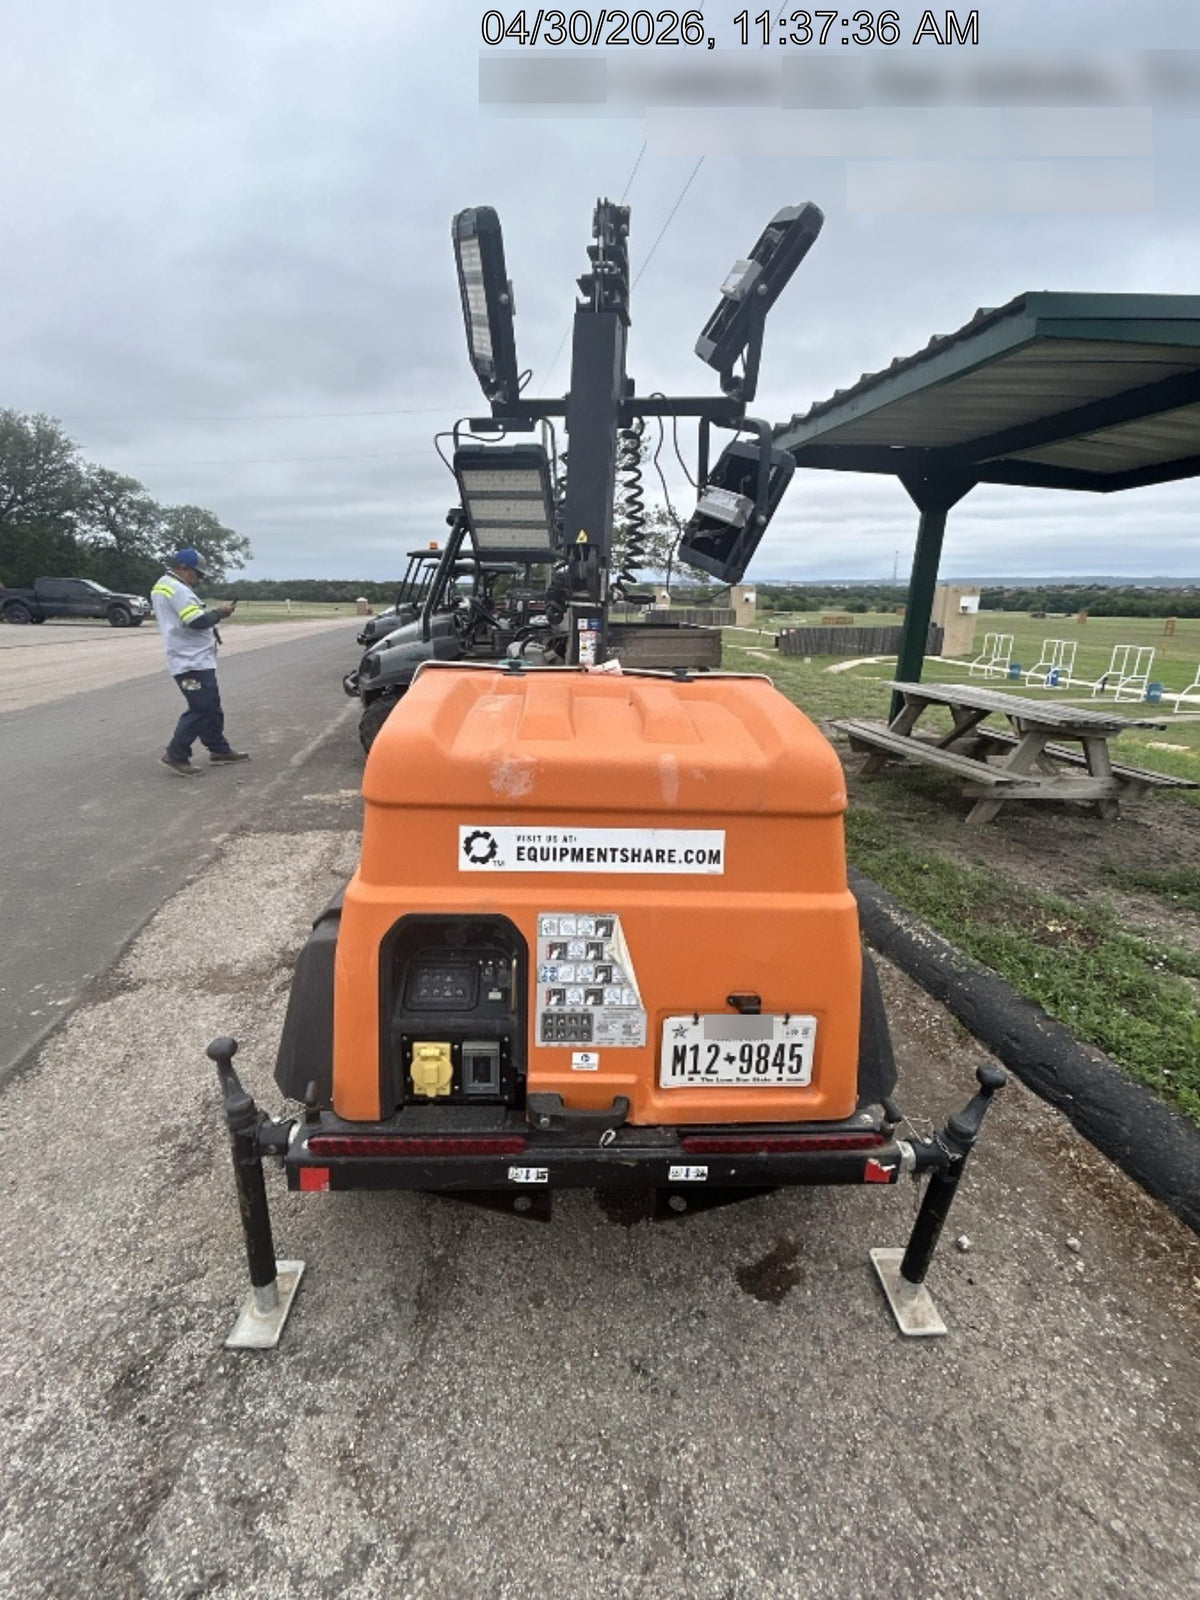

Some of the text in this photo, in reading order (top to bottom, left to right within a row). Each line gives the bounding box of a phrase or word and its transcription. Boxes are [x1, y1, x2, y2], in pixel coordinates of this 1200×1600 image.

[516, 835, 542, 843] VISIT
[546, 835, 558, 843] US
[516, 846, 721, 865] EQUIPMENTSHARE.COM
